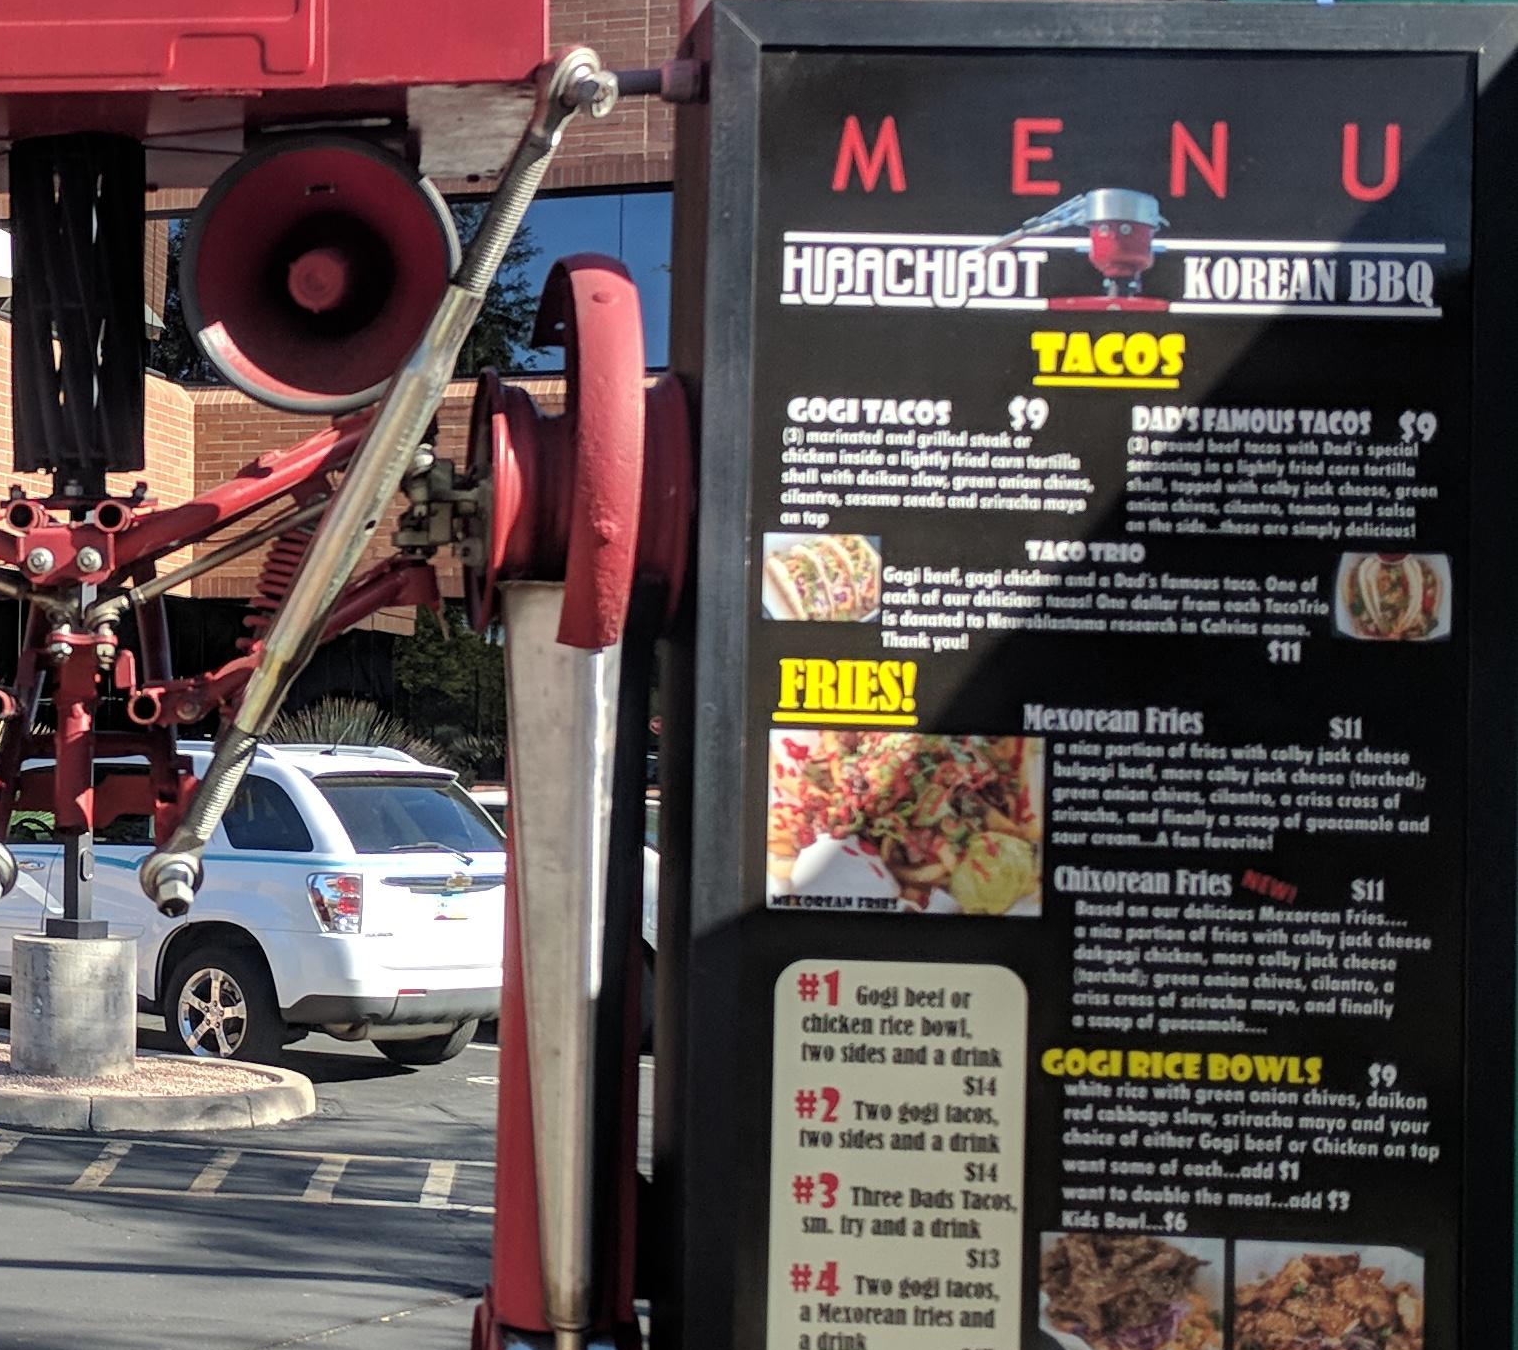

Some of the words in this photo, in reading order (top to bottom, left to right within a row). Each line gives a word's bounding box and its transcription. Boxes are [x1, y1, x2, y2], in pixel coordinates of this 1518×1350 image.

[831, 114, 1401, 202] MENU
[782, 245, 1049, 309] HIBACHIBOT
[1182, 254, 1338, 303] KOREAN
[1348, 259, 1435, 308] BBQ
[1031, 330, 1186, 377] TACOS
[786, 397, 859, 423] GOGI
[861, 399, 951, 425] TACOS
[1008, 395, 1048, 430] $9
[1132, 405, 1199, 432] DAD'S
[1202, 408, 1295, 433] FAMOUS
[1298, 410, 1371, 434] TACOS
[1398, 410, 1436, 444] $9
[1024, 540, 1085, 561] TACO
[1088, 542, 1145, 562] TRIO
[1267, 639, 1300, 661] $11
[778, 657, 918, 712] FRIES!
[1023, 704, 1139, 732] Mexorean
[1144, 707, 1203, 734] Fries
[1329, 717, 1361, 739] $11
[1053, 866, 1170, 893] Chixorean
[1175, 869, 1232, 895] Fries
[1240, 868, 1298, 905] NEW!
[1351, 879, 1384, 901] $11
[796, 969, 840, 1007] #1
[801, 1013, 873, 1034] chicken
[879, 1015, 914, 1035] rice
[920, 1017, 972, 1038] bowl,
[801, 1042, 834, 1061] two
[840, 1043, 886, 1063] sides
[892, 1045, 927, 1065] and
[933, 1048, 945, 1065] a
[950, 1046, 1002, 1067] drink
[1041, 1048, 1122, 1076] GOGI
[1127, 1050, 1202, 1079] RICE
[1207, 1053, 1322, 1083] BOWLS
[963, 1075, 996, 1096] $14
[1368, 1063, 1397, 1087] $9
[795, 1086, 841, 1124] #2
[964, 1161, 997, 1182] $14
[792, 1172, 840, 1210] #3
[790, 1261, 841, 1298] #4
